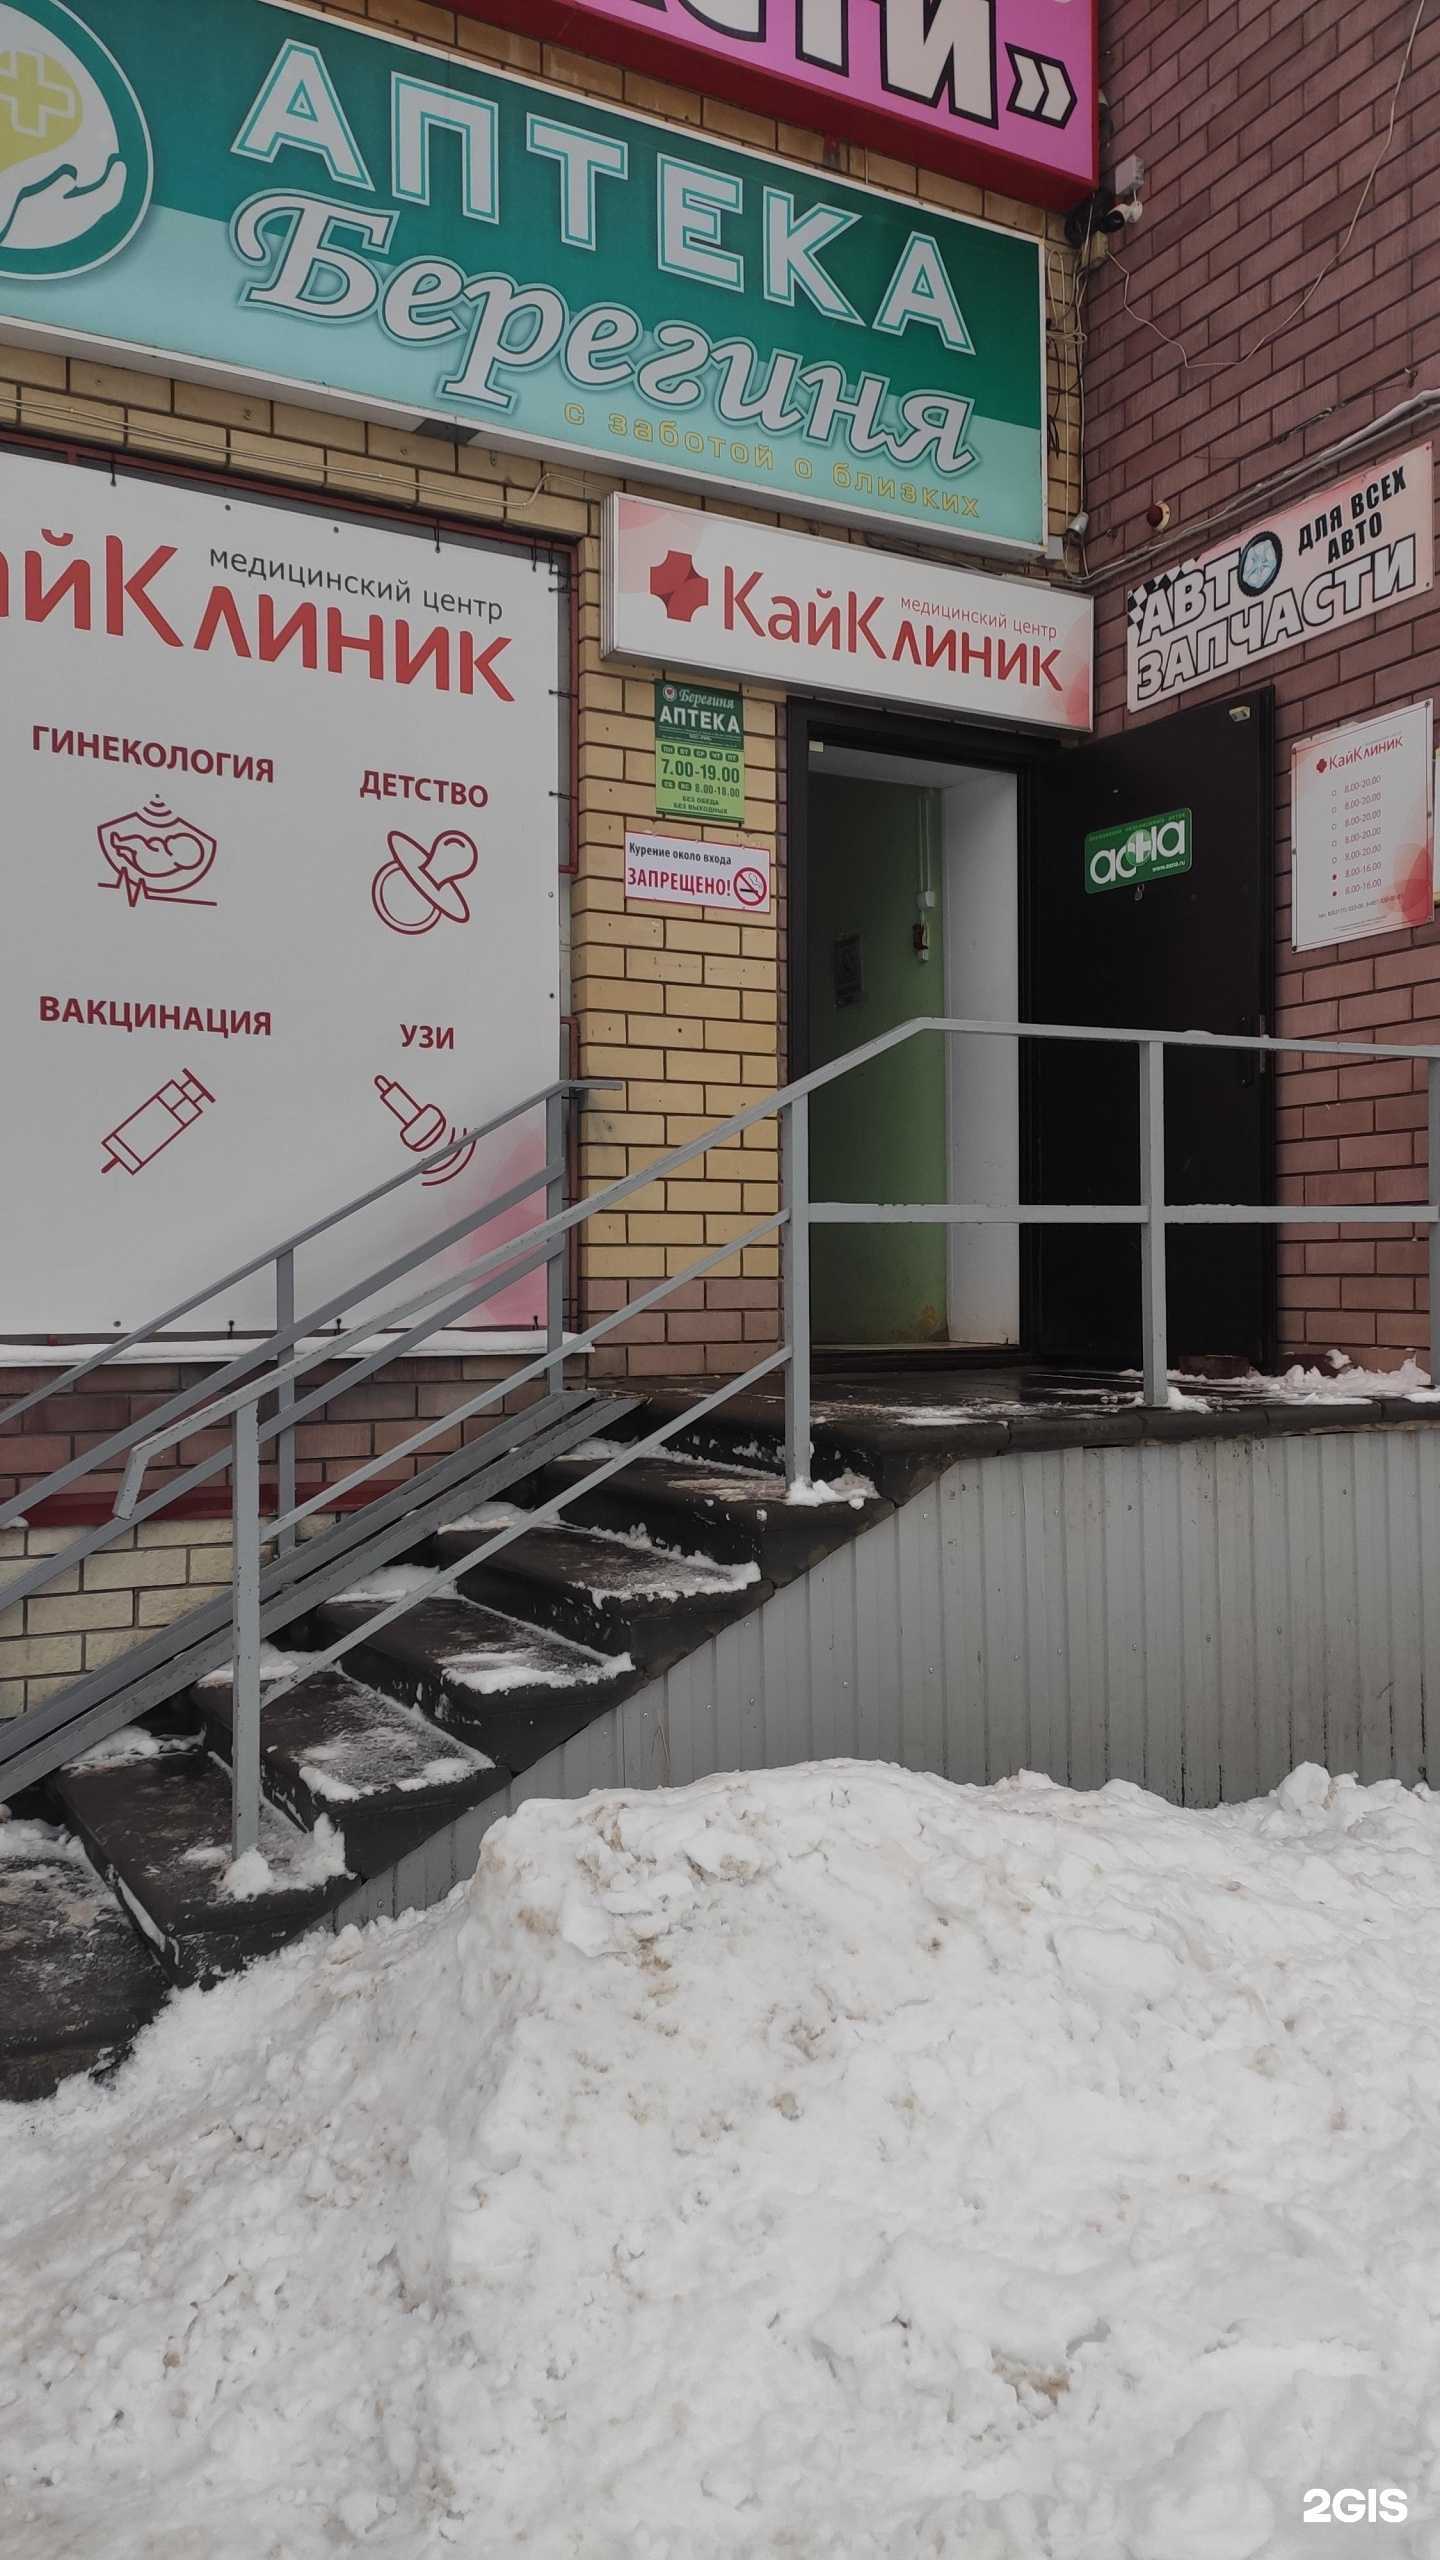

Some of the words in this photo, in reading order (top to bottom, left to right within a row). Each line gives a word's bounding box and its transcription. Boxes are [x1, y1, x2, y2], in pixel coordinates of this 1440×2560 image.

[231, 38, 976, 355] АПТЕКА
[229, 188, 982, 480] Берегиня
[609, 412, 774, 470] заботой
[832, 457, 980, 519] близких
[1298, 504, 1342, 556] ДЛЯ
[1350, 466, 1406, 519] ВСЕХ
[1327, 511, 1382, 565] АВТО
[210, 547, 411, 604] медицинский
[423, 587, 503, 622] центр
[724, 565, 1063, 692] КайКлиник
[900, 596, 1007, 630] медицинский
[1013, 618, 1057, 643] центр
[1137, 533, 1416, 701] ЗАПЧАСТИ
[660, 705, 740, 734] АПТЕКА
[679, 688, 735, 709] Берегиня
[32, 725, 274, 783] ГИНЕКОЛОГИЯ
[661, 759, 740, 783] 7.00-19.00
[360, 769, 488, 808] ДЕТСТВО
[629, 842, 671, 857] Курение
[673, 850, 701, 862] около
[703, 854, 732, 865] входа
[628, 867, 731, 896] ЗАПРЕЩЕНО!
[39, 996, 272, 1038] ВАКЦИНАЦИЯ
[400, 1024, 455, 1049] УЗИ
